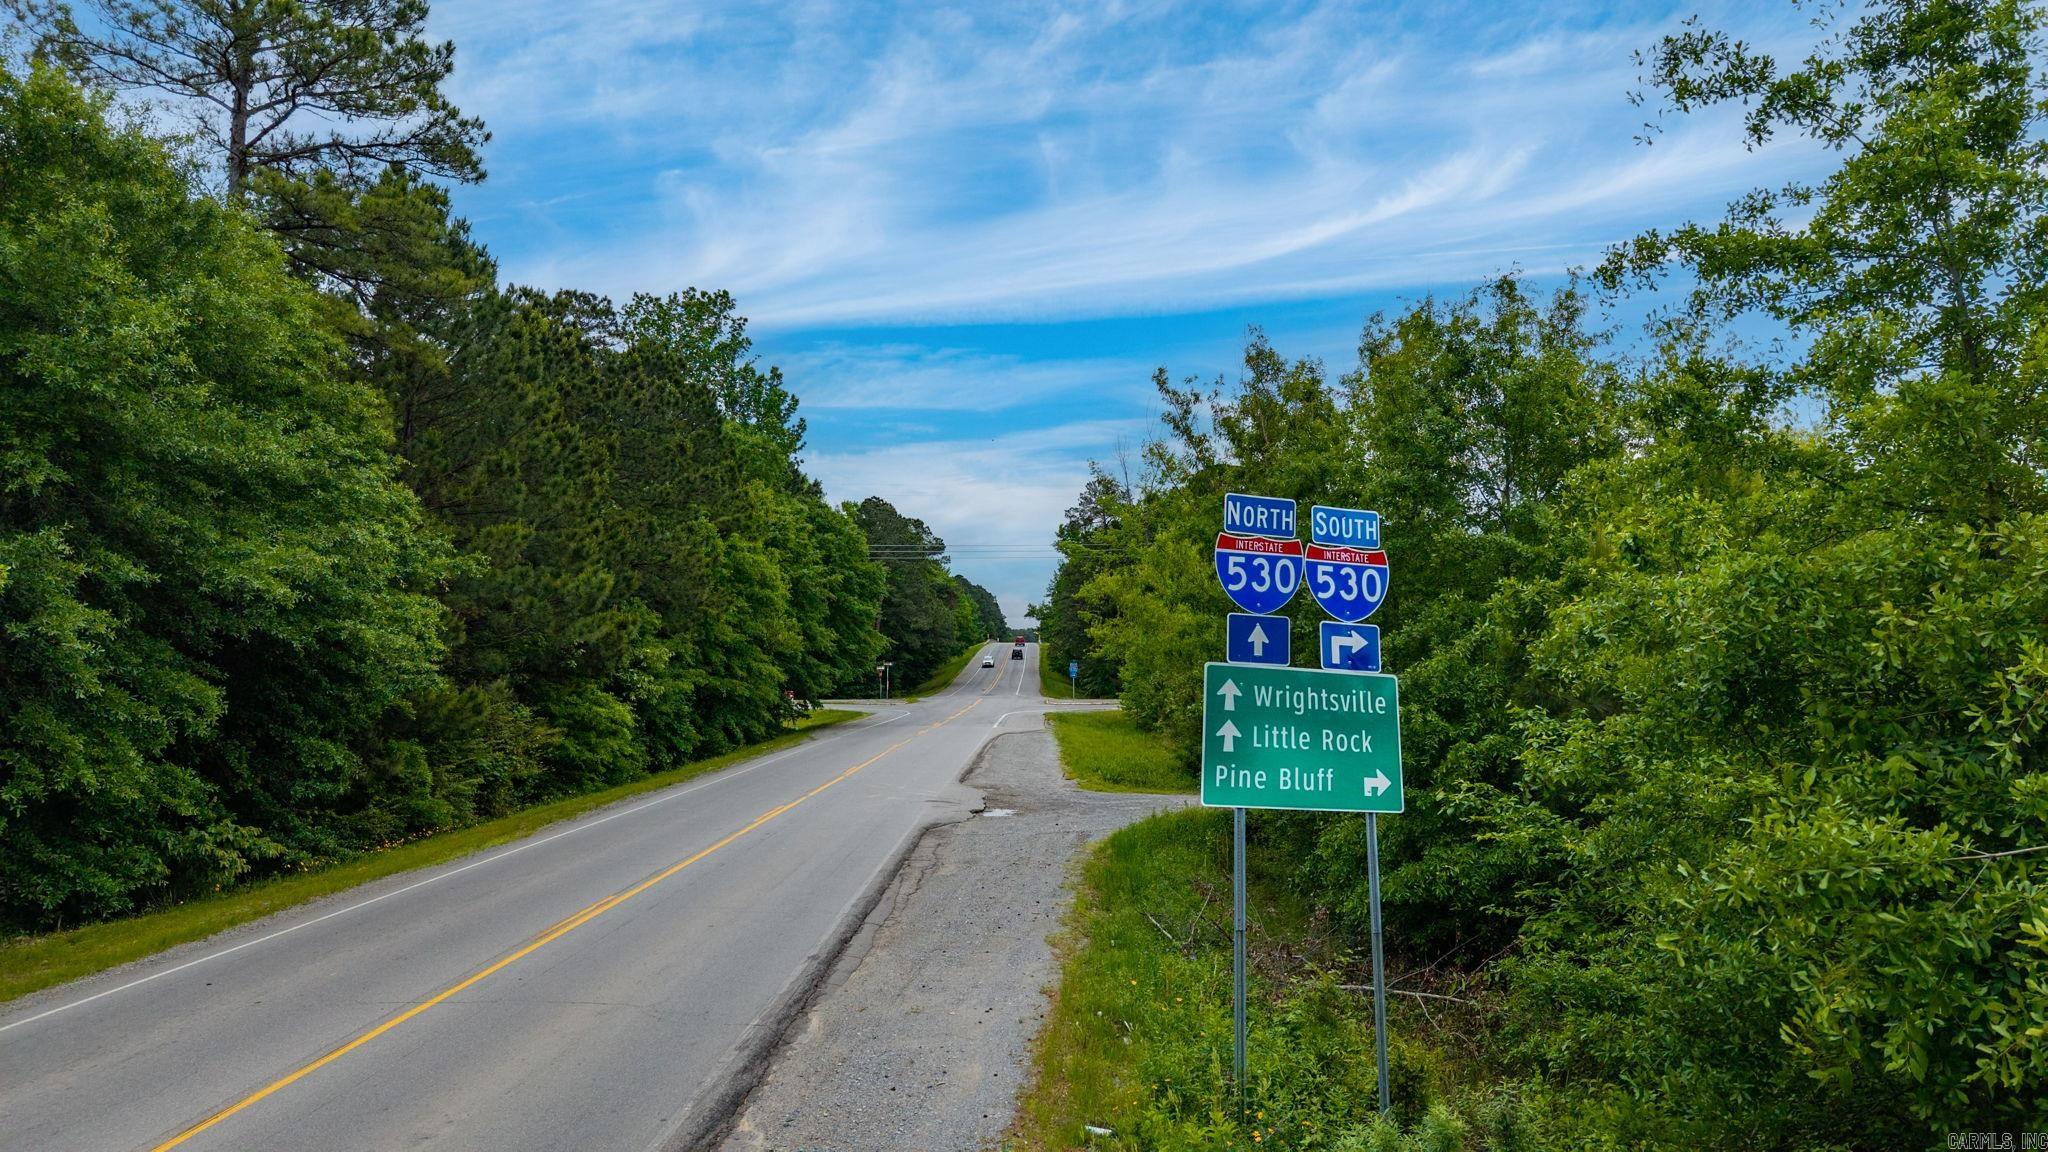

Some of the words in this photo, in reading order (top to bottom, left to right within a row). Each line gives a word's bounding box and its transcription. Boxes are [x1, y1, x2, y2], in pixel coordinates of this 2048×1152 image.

[1227, 500, 1294, 531] NORTH
[1315, 511, 1376, 540] SOUTH
[1235, 539, 1283, 553] INTERSTATE
[1323, 550, 1369, 563] INTERSTATE
[1228, 556, 1296, 594] 530
[1317, 566, 1381, 603] 530
[1254, 685, 1386, 714] Wrightsville
[1253, 725, 1310, 750] Little
[1323, 730, 1372, 753] Rock
[1216, 765, 1266, 789] Pine
[1280, 768, 1334, 791] Bluff
